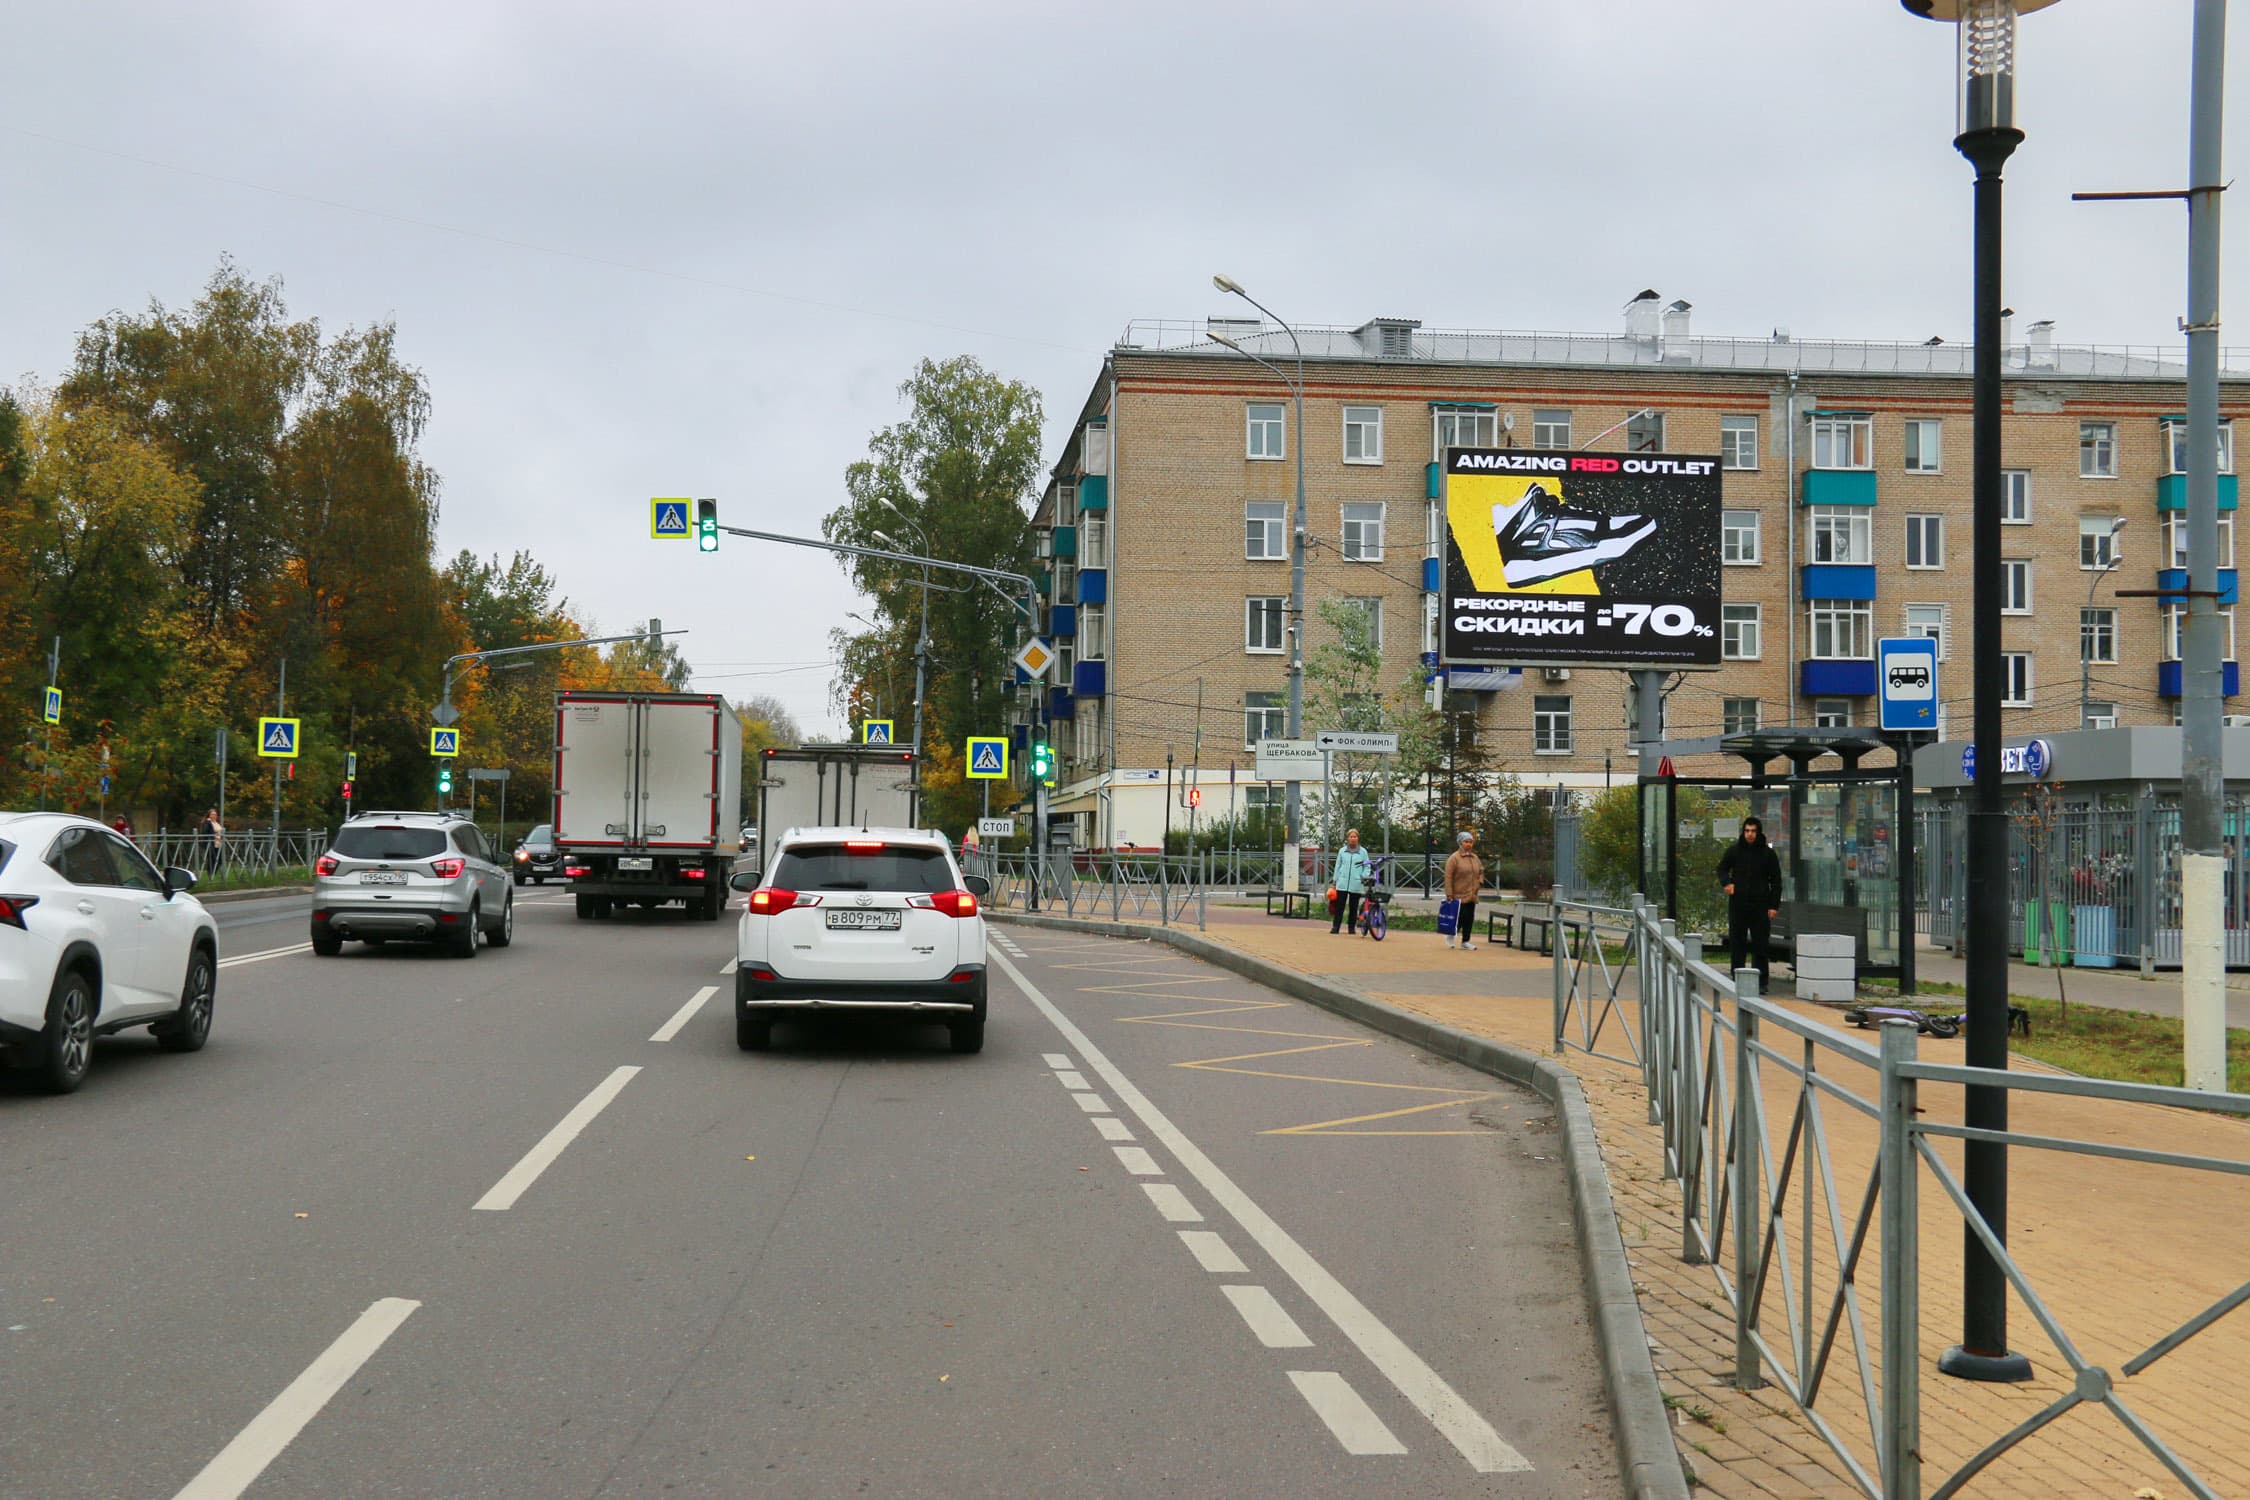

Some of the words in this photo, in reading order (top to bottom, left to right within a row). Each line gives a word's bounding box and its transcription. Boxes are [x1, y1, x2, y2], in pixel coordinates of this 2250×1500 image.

[1456, 454, 1567, 471] AMAZING
[1571, 458, 1620, 472] RED
[1622, 459, 1715, 476] OUTLET
[1454, 598, 1586, 613] РЕКОРДНЫЕ
[1454, 615, 1585, 637] СКИДКИ
[1266, 749, 1317, 757] ЩЕРБАКОВА
[983, 822, 1009, 832] СТОП
